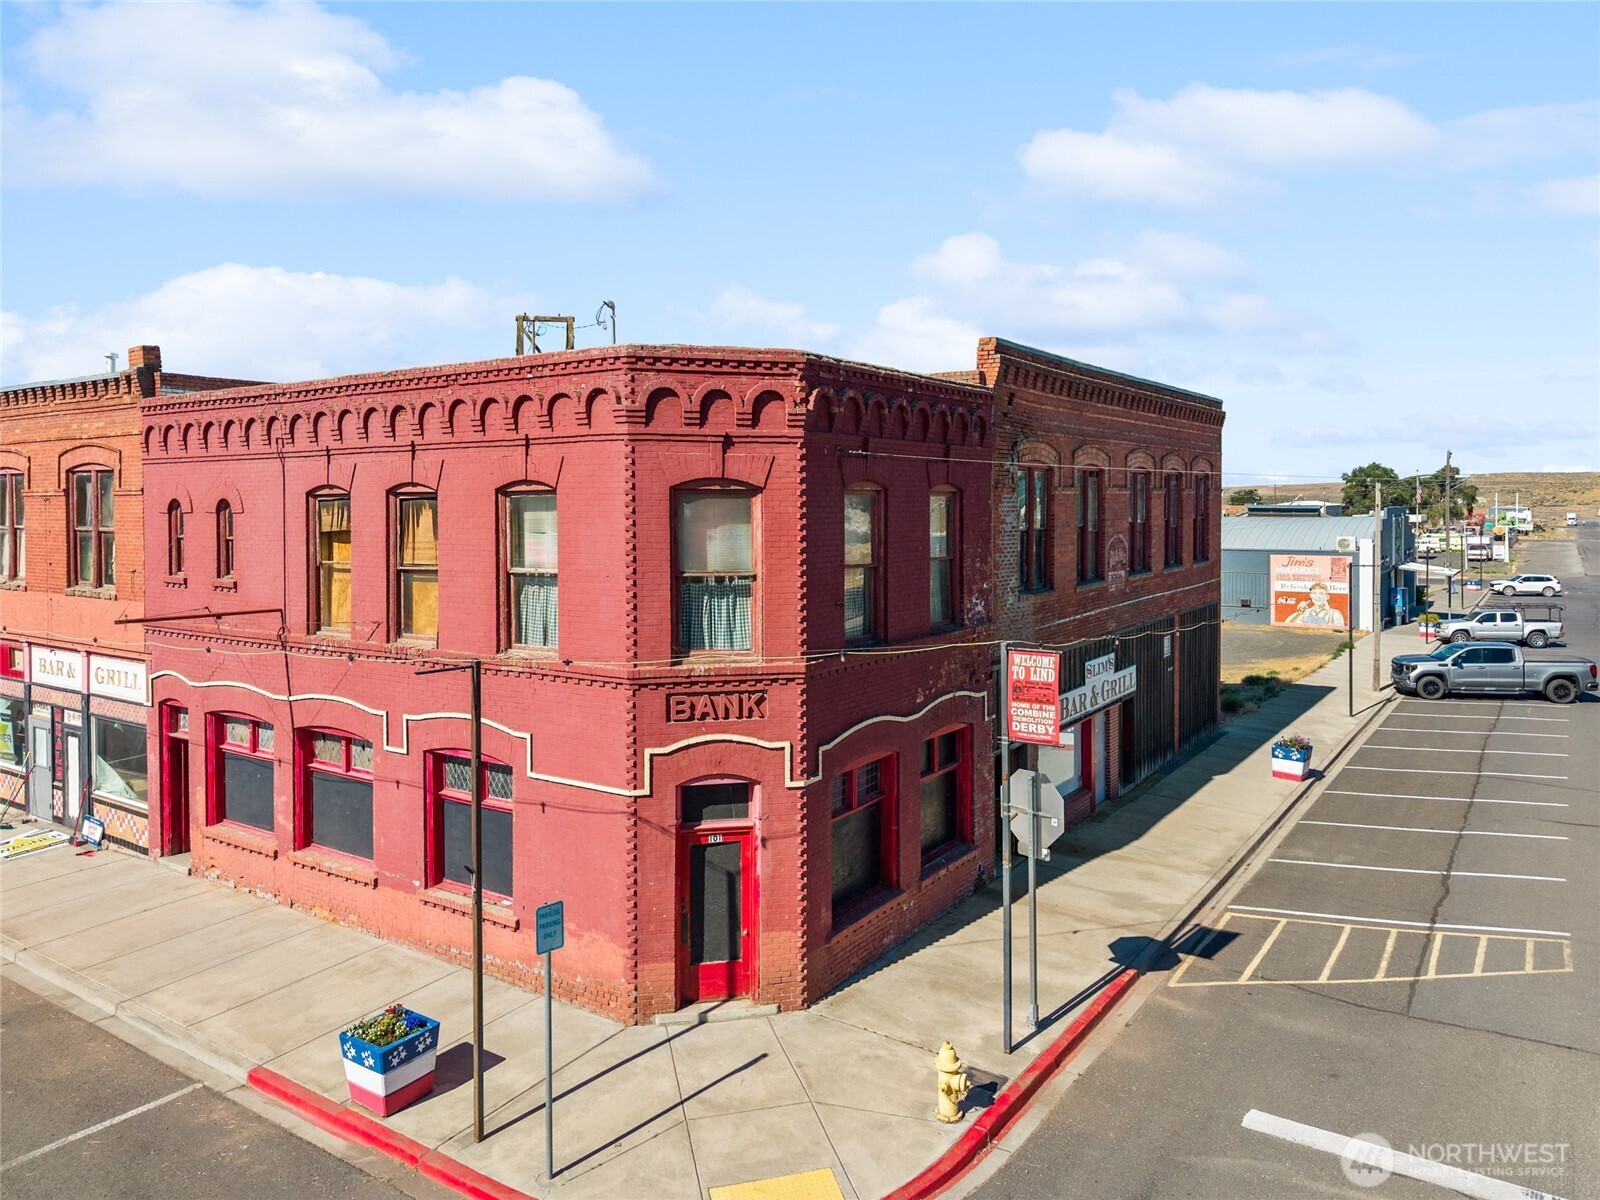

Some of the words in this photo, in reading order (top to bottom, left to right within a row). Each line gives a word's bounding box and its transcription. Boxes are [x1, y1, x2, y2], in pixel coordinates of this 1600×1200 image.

[1281, 555, 1315, 568] Jim's
[1275, 566, 1322, 574] MARKET
[1329, 584, 1347, 592] Here
[1013, 654, 1055, 668] WELCOME
[39, 657, 65, 677] BAR
[67, 661, 76, 679] &
[1012, 665, 1025, 680] TO
[1030, 667, 1055, 682] LIND
[94, 666, 142, 690] GRILL
[1059, 692, 1087, 719] BAR
[1090, 684, 1100, 708] &
[1101, 671, 1136, 702] GRILL
[670, 693, 765, 722] BANK
[1011, 701, 1031, 709] HOME
[1011, 707, 1056, 719] COMBINE
[1012, 715, 1054, 725] DEMOLITION
[1012, 721, 1055, 735] DERBY
[709, 834, 721, 843] 101
[543, 930, 557, 940] ONLY
